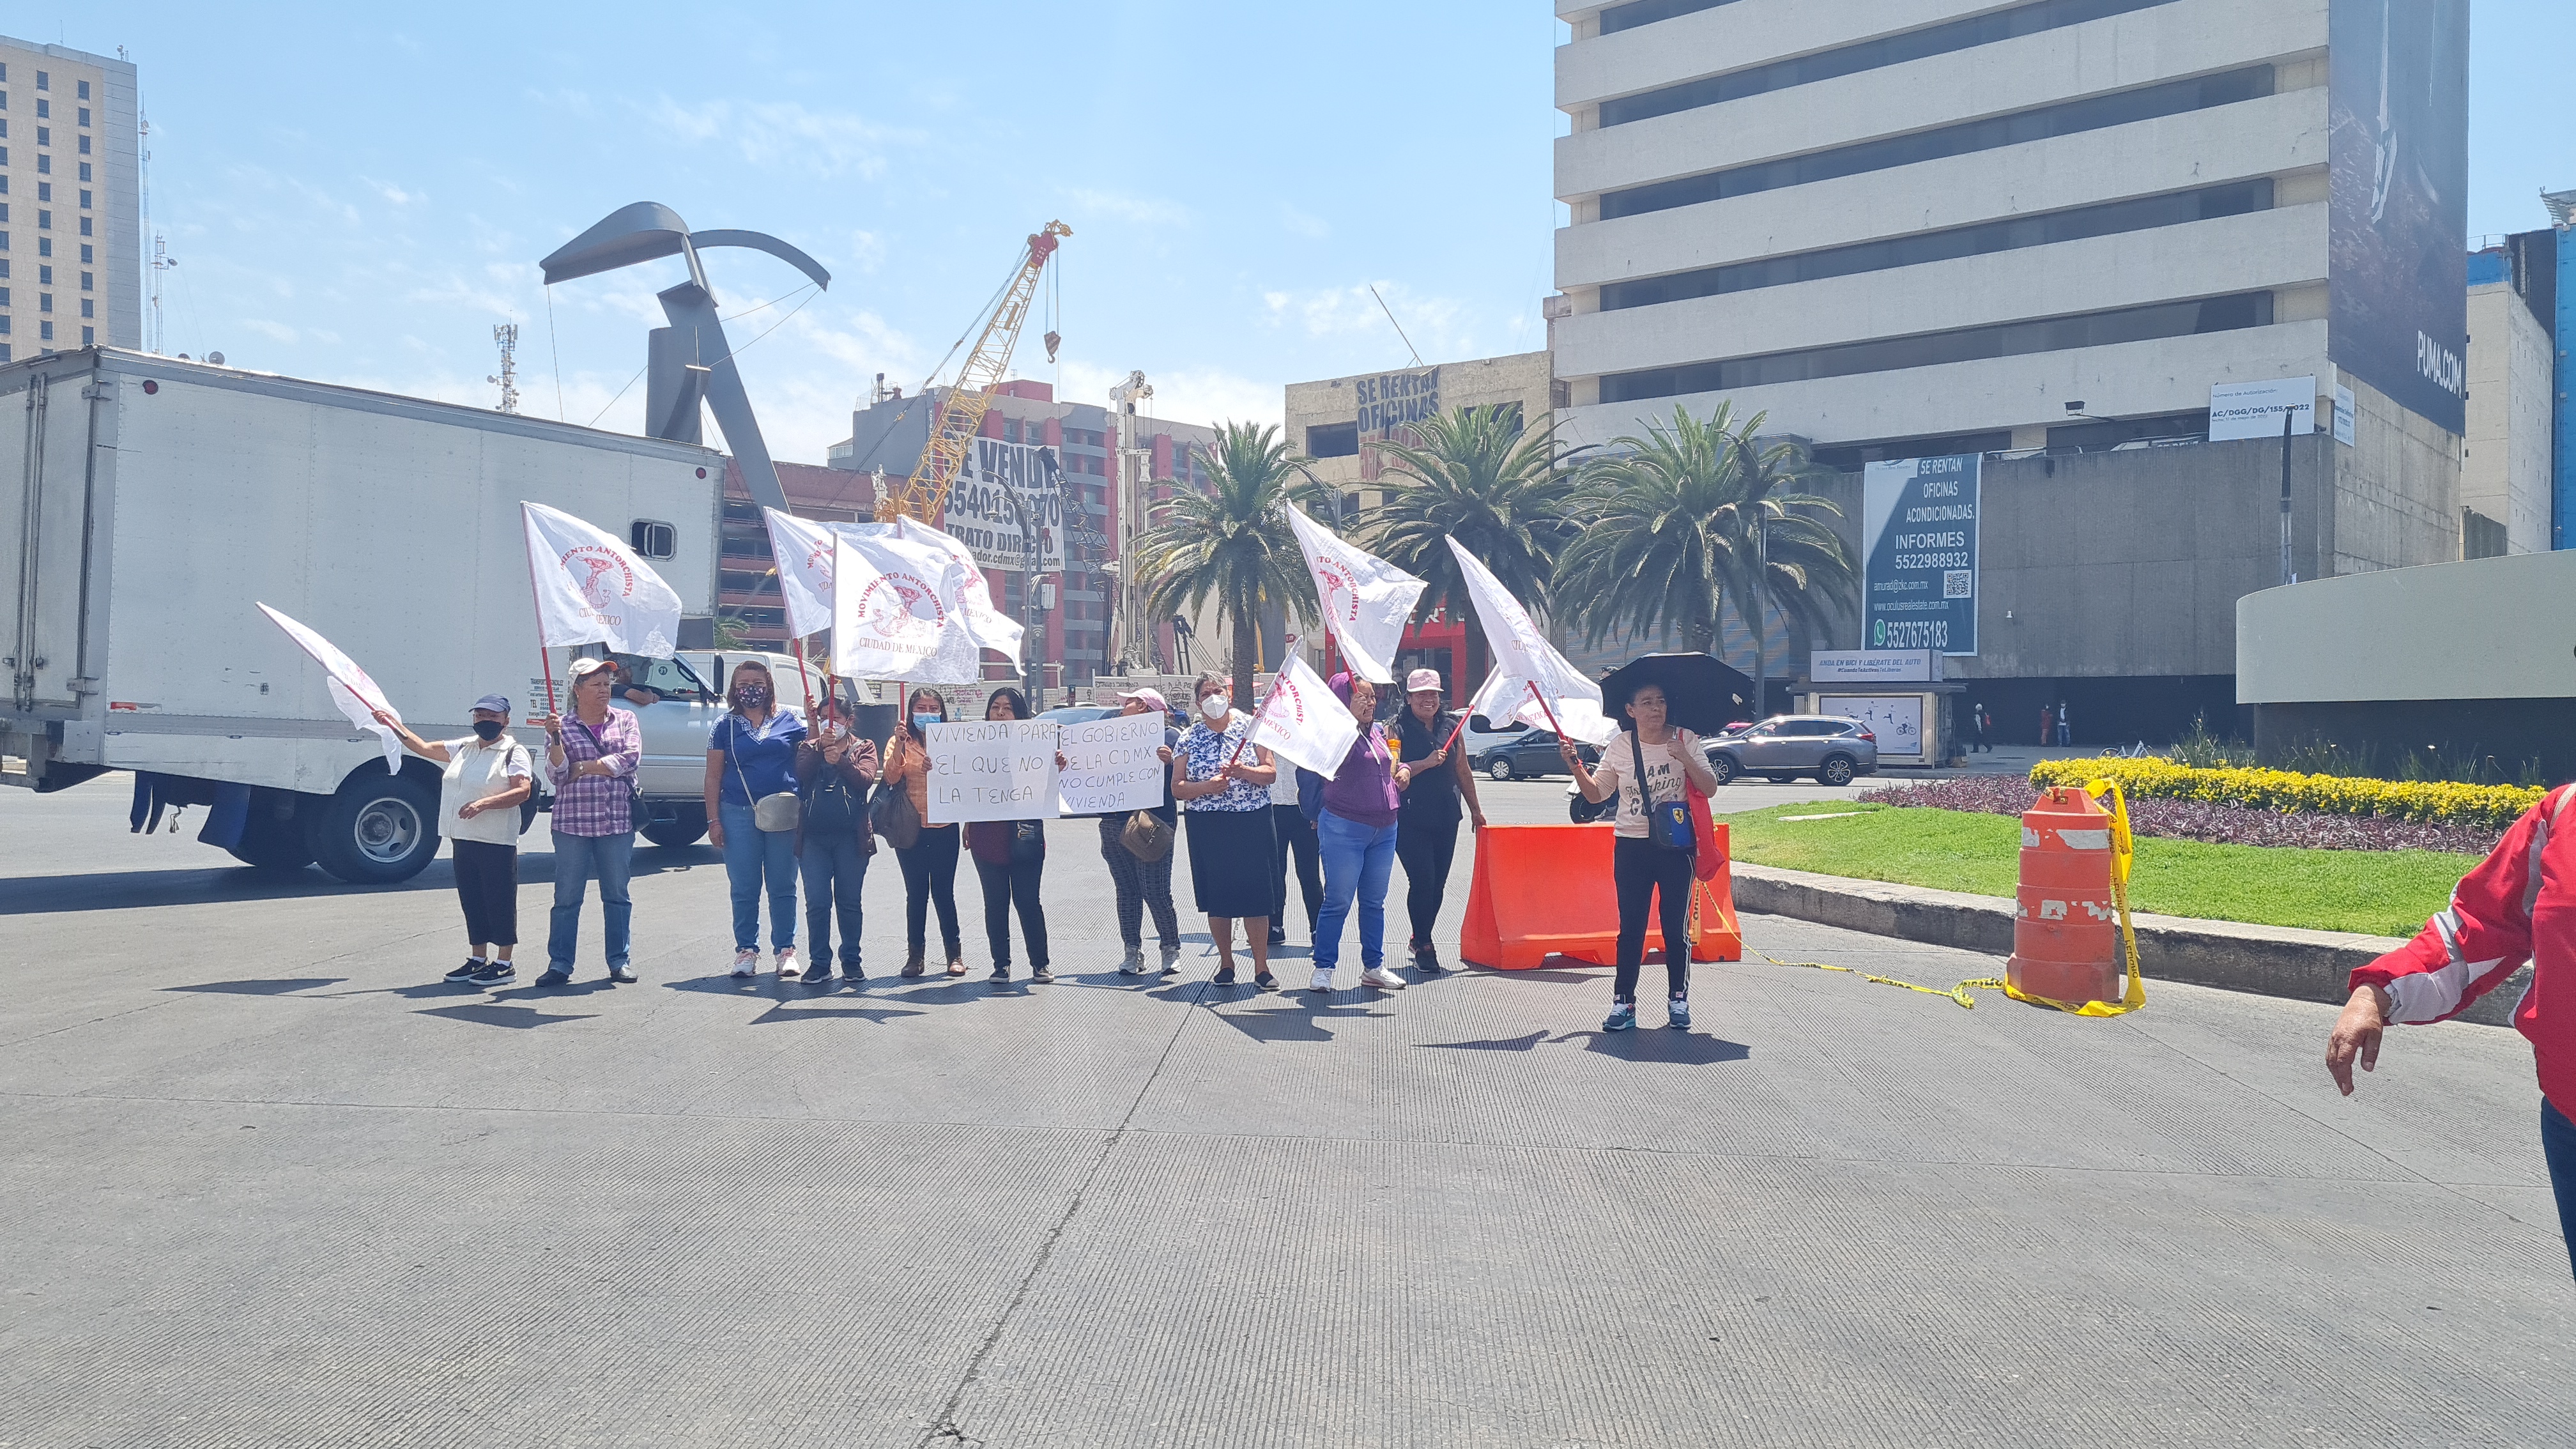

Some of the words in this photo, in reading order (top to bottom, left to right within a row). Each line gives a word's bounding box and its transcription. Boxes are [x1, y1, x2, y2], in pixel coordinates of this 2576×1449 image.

[2418, 330, 2461, 399] PUMA.COM
[1357, 378, 1377, 405] SE
[1358, 392, 1439, 433] OFICINAS
[2212, 404, 2310, 417] AC/DGG/DG/155/022
[1920, 460, 1931, 474] SE
[1932, 457, 1963, 473] RENTAN
[1923, 480, 1958, 498] OFICINAS
[1906, 503, 1975, 523] ACONDICIONADAS.
[946, 523, 993, 549] TRATO
[1896, 531, 1965, 550] INFORMES
[1895, 551, 1968, 570] 5522988932
[595, 546, 634, 597] ANTORCHISTA
[858, 572, 899, 618] MOVIMIENTO
[901, 572, 945, 628] ANTORCHISTA
[1887, 620, 1948, 648] 5527675183
[859, 637, 891, 651] CIUDAD
[893, 642, 904, 653] DE
[1864, 658, 1892, 666] LIBÉRATE
[930, 723, 1009, 743] VIVIENDA
[1018, 723, 1057, 743] PARA
[1061, 728, 1078, 746] EL
[1082, 722, 1159, 742] GOBIERNO
[935, 755, 962, 775] EL
[972, 756, 1011, 773] QUE
[1019, 755, 1043, 772] NO
[1086, 754, 1102, 770] LA
[1647, 763, 1670, 778] AM
[1059, 778, 1082, 788] NO
[1085, 772, 1136, 788] CUMPLE
[1138, 763, 1161, 780] CON
[939, 786, 961, 804] LA
[972, 785, 1033, 804] TENGA
